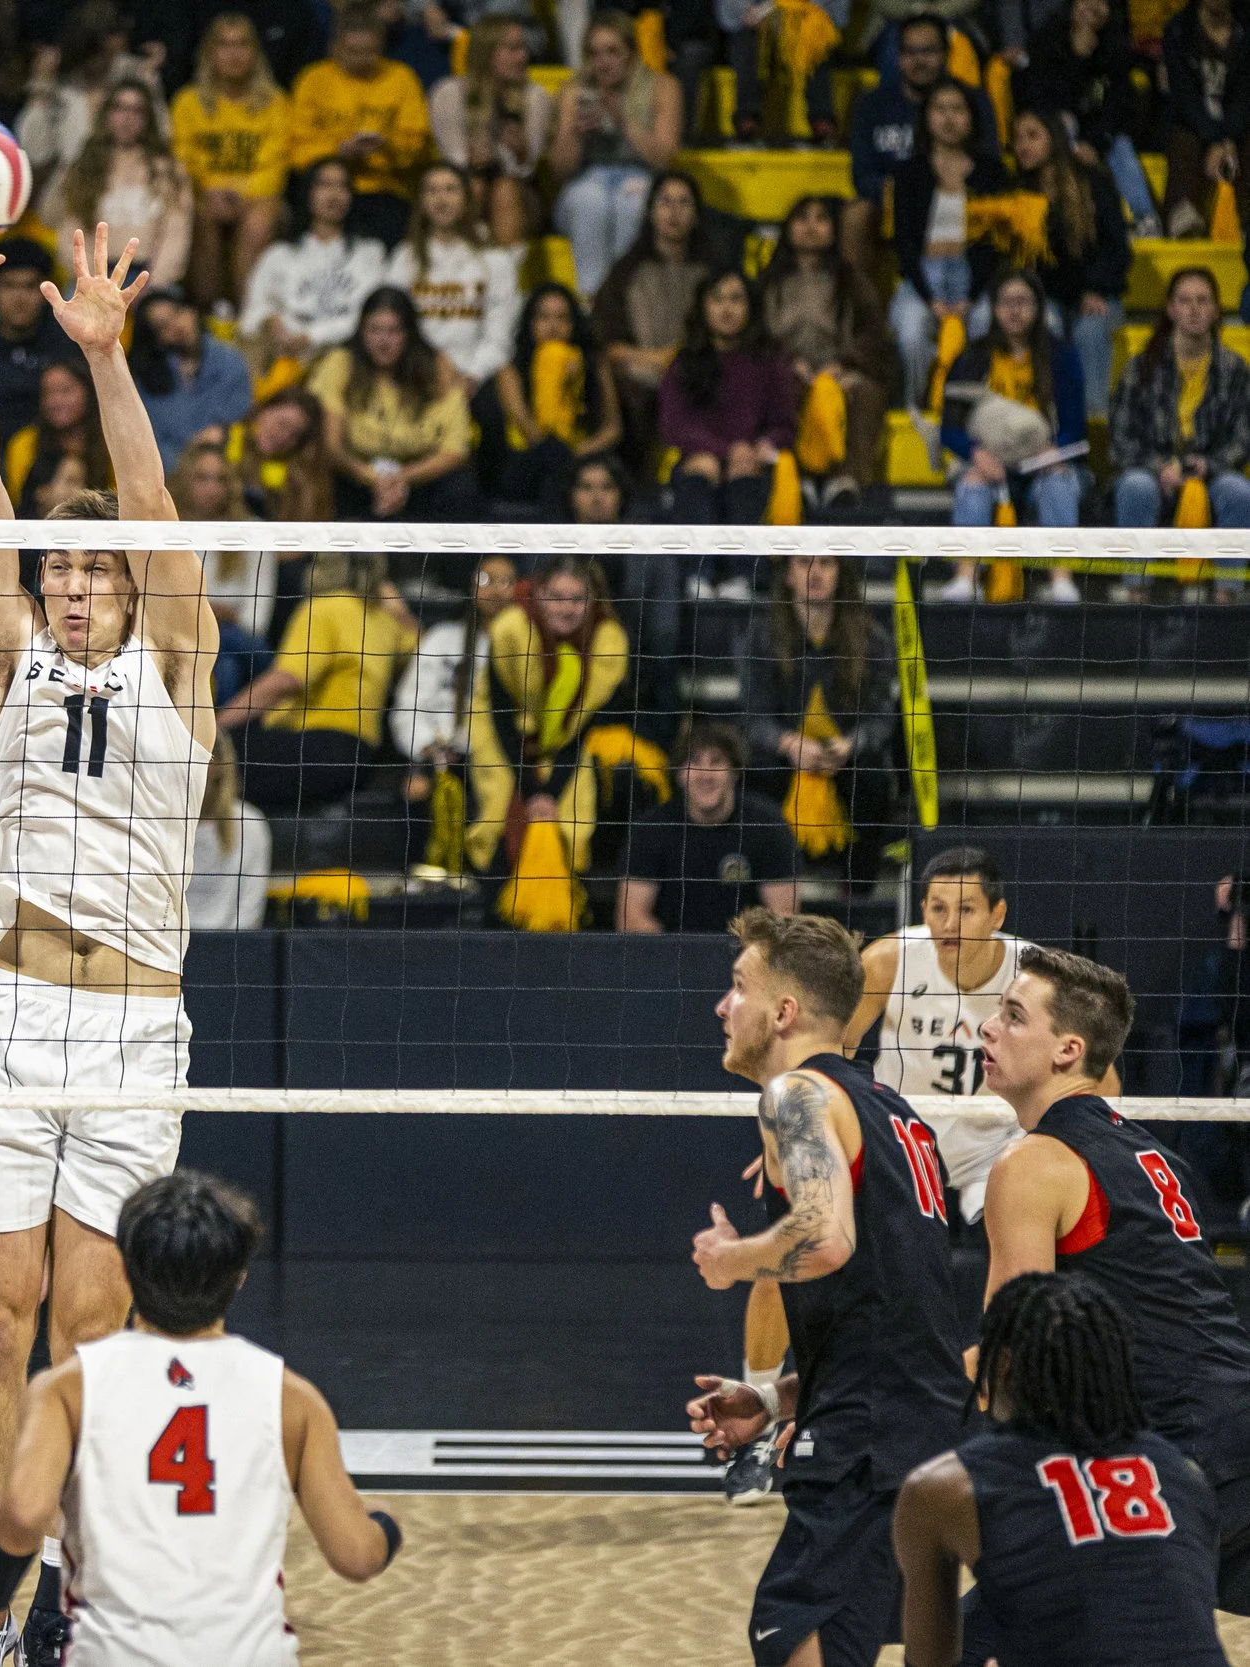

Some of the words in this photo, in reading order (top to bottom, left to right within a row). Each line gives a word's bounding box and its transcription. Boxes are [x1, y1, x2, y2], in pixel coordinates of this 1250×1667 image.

[61, 694, 110, 778] 11
[911, 1016, 985, 1039] BEA
[932, 1045, 985, 1096] 31
[889, 1114, 948, 1226] 10
[1135, 1150, 1202, 1243] 8
[148, 1404, 216, 1517] 4
[1035, 1453, 1177, 1547] 18
